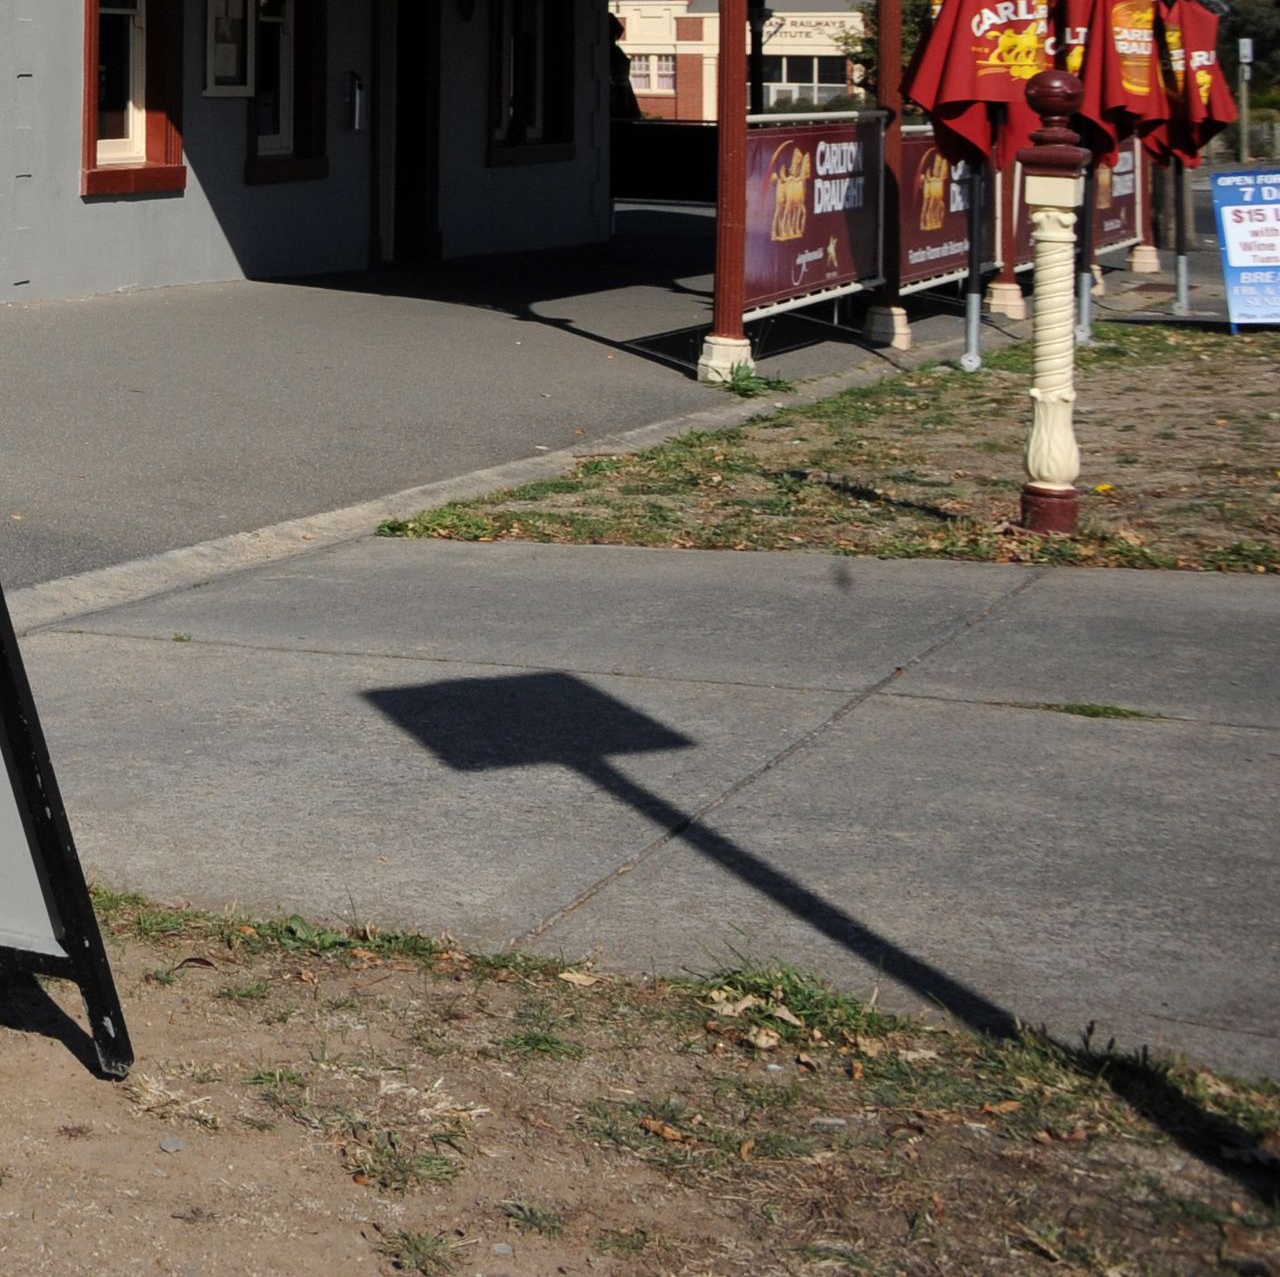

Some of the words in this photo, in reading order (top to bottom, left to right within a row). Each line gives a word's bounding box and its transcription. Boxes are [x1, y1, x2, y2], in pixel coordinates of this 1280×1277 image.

[816, 141, 863, 176] CARLTON
[814, 177, 865, 214] DRAUGHT
[1239, 187, 1255, 202] 7
[1232, 209, 1265, 223] $15
